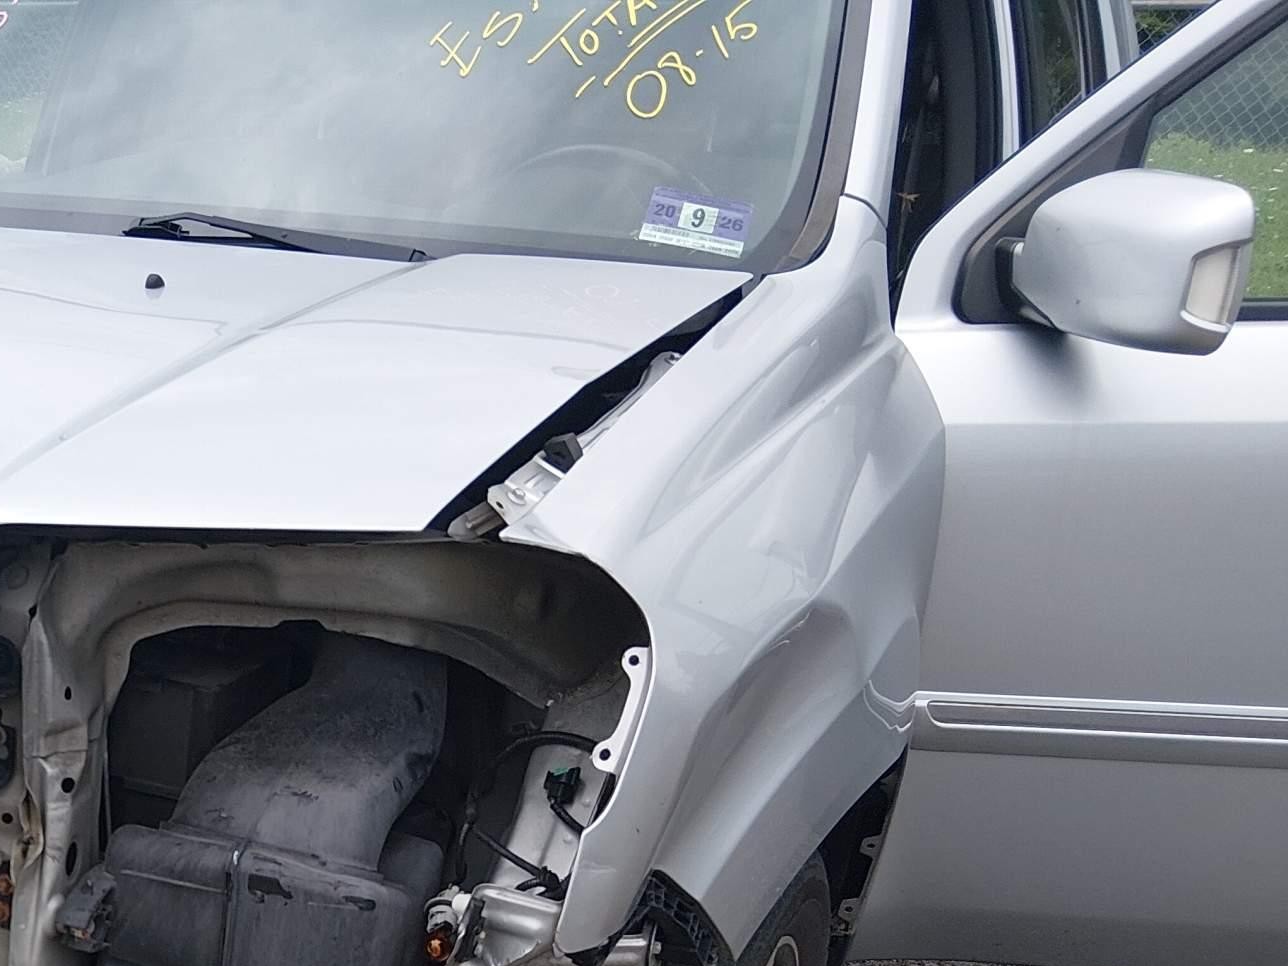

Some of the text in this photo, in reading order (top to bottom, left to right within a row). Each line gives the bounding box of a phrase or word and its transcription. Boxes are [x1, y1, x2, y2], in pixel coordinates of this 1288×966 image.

[653, 203, 745, 232] 20 9 26
